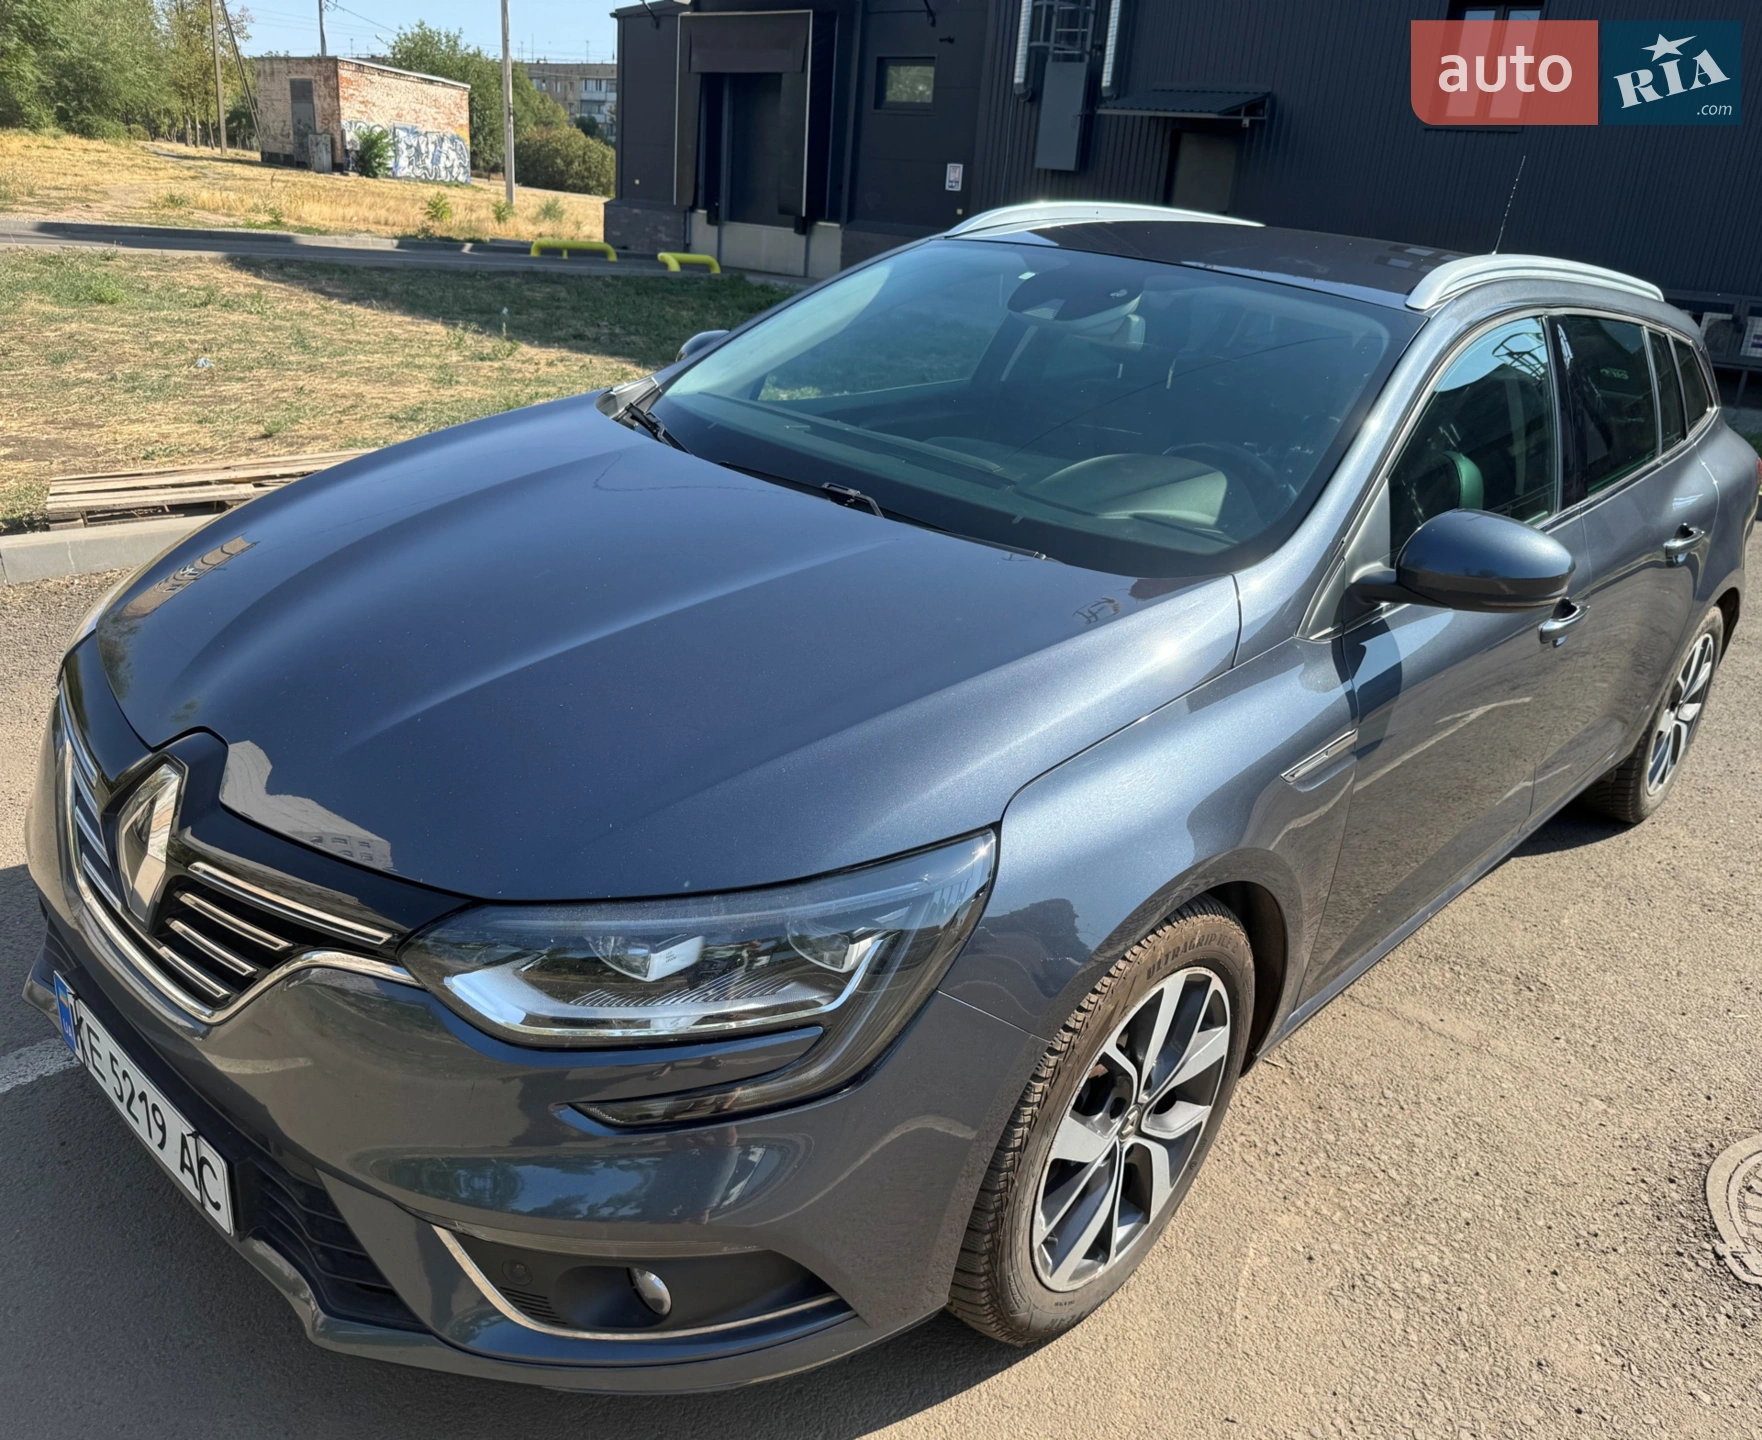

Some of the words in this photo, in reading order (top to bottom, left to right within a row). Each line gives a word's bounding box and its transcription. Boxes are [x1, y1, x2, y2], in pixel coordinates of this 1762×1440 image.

[1146, 933, 1217, 980] ULTRAGRIP
[62, 1017, 74, 1038] UA
[70, 1002, 107, 1083] KE
[108, 1049, 168, 1151] 5219
[179, 1130, 222, 1212] AC
